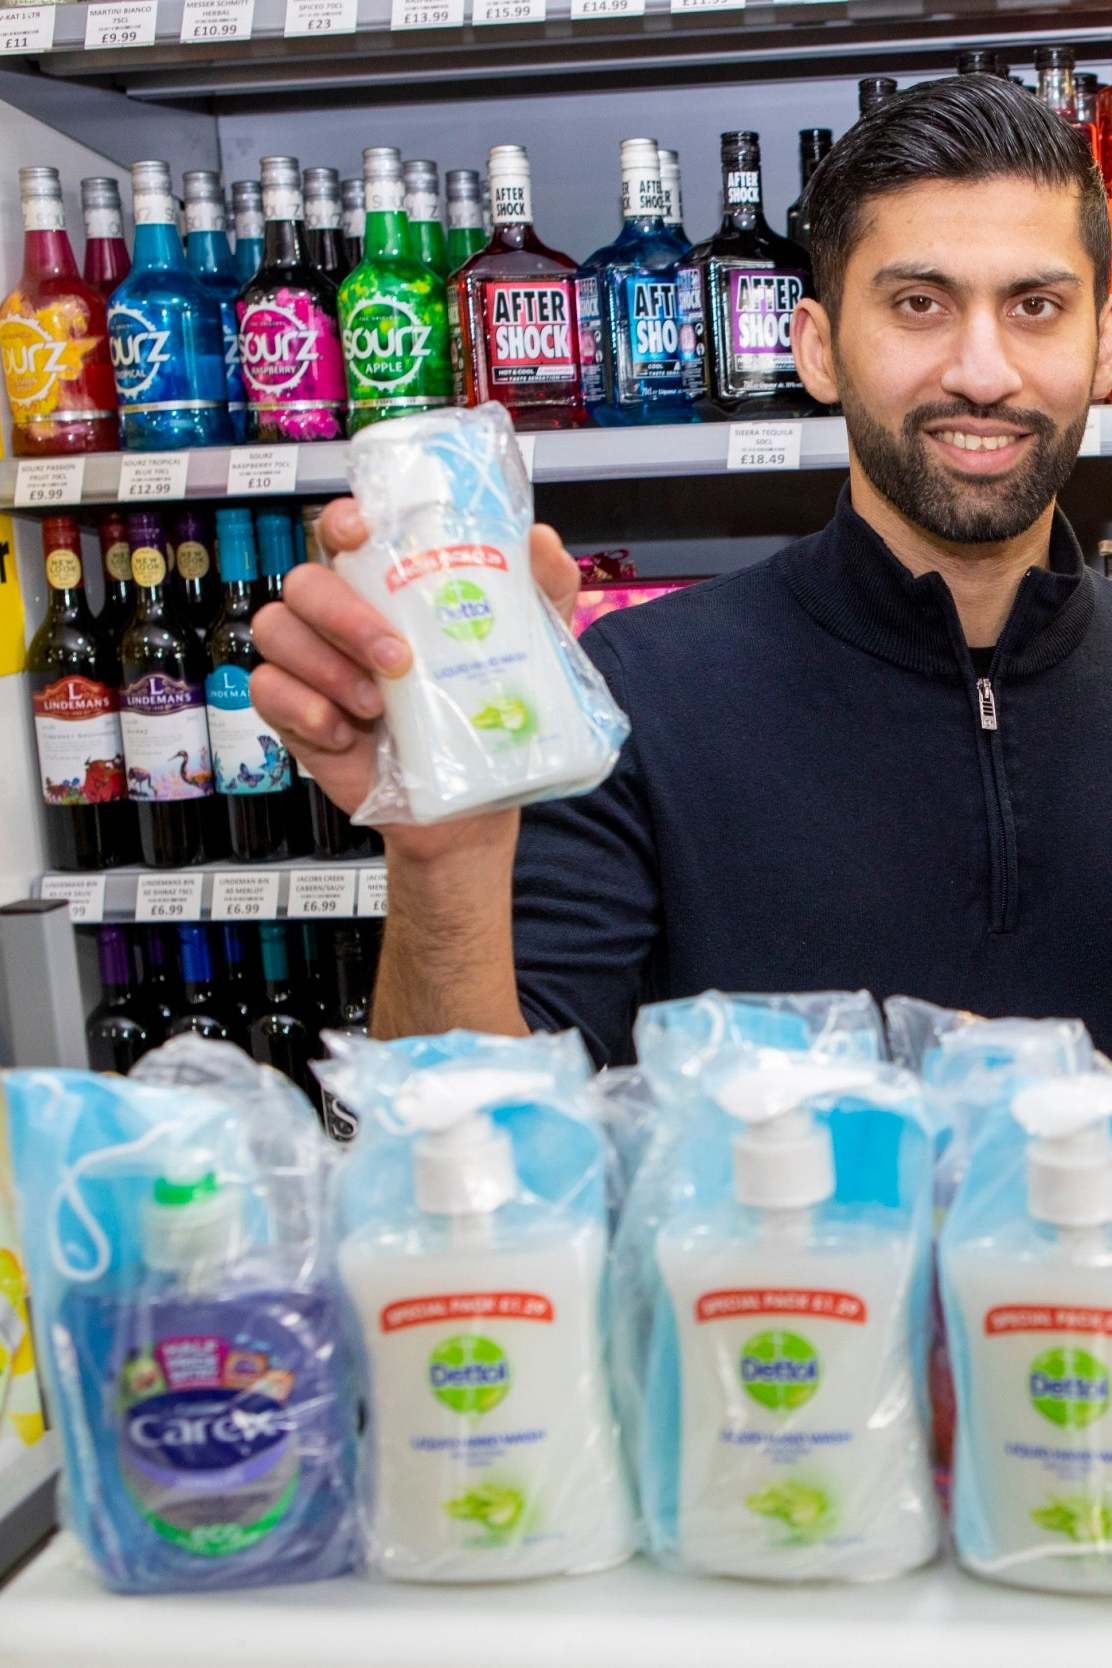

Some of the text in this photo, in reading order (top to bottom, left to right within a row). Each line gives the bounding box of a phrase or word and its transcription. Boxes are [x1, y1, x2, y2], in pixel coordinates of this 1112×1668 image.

[123, 6, 152, 14] BIANCO
[486, 6, 531, 19] £15.99
[404, 11, 449, 24] £13.99
[194, 25, 238, 36] £10.99
[308, 19, 331, 30] £23
[6, 38, 29, 49] £11
[102, 32, 137, 44] £9.99
[728, 171, 759, 188] AFTER
[496, 187, 524, 201] AFTER
[728, 185, 759, 204] SHOCK
[496, 202, 526, 216] SHOCK
[736, 275, 803, 312] AFTER
[493, 288, 569, 325] AFTER
[634, 283, 678, 319] AFT
[637, 320, 678, 354] SHO
[738, 312, 792, 349] SHOC
[344, 326, 432, 360] sourz
[496, 324, 571, 360] SHOCK
[365, 362, 403, 373] APPLE
[741, 454, 785, 465] £18.49
[248, 477, 271, 489] £10
[30, 488, 63, 501] £9.99
[129, 484, 171, 496] £12.99
[151, 905, 183, 916] £6.99
[227, 903, 260, 915] £6.99
[303, 900, 336, 912] £6.99
[430, 1362, 508, 1388] Dettol
[740, 1356, 817, 1382] Dettol
[1029, 1370, 1109, 1397] Dettol
[129, 1410, 278, 1449] Carex
